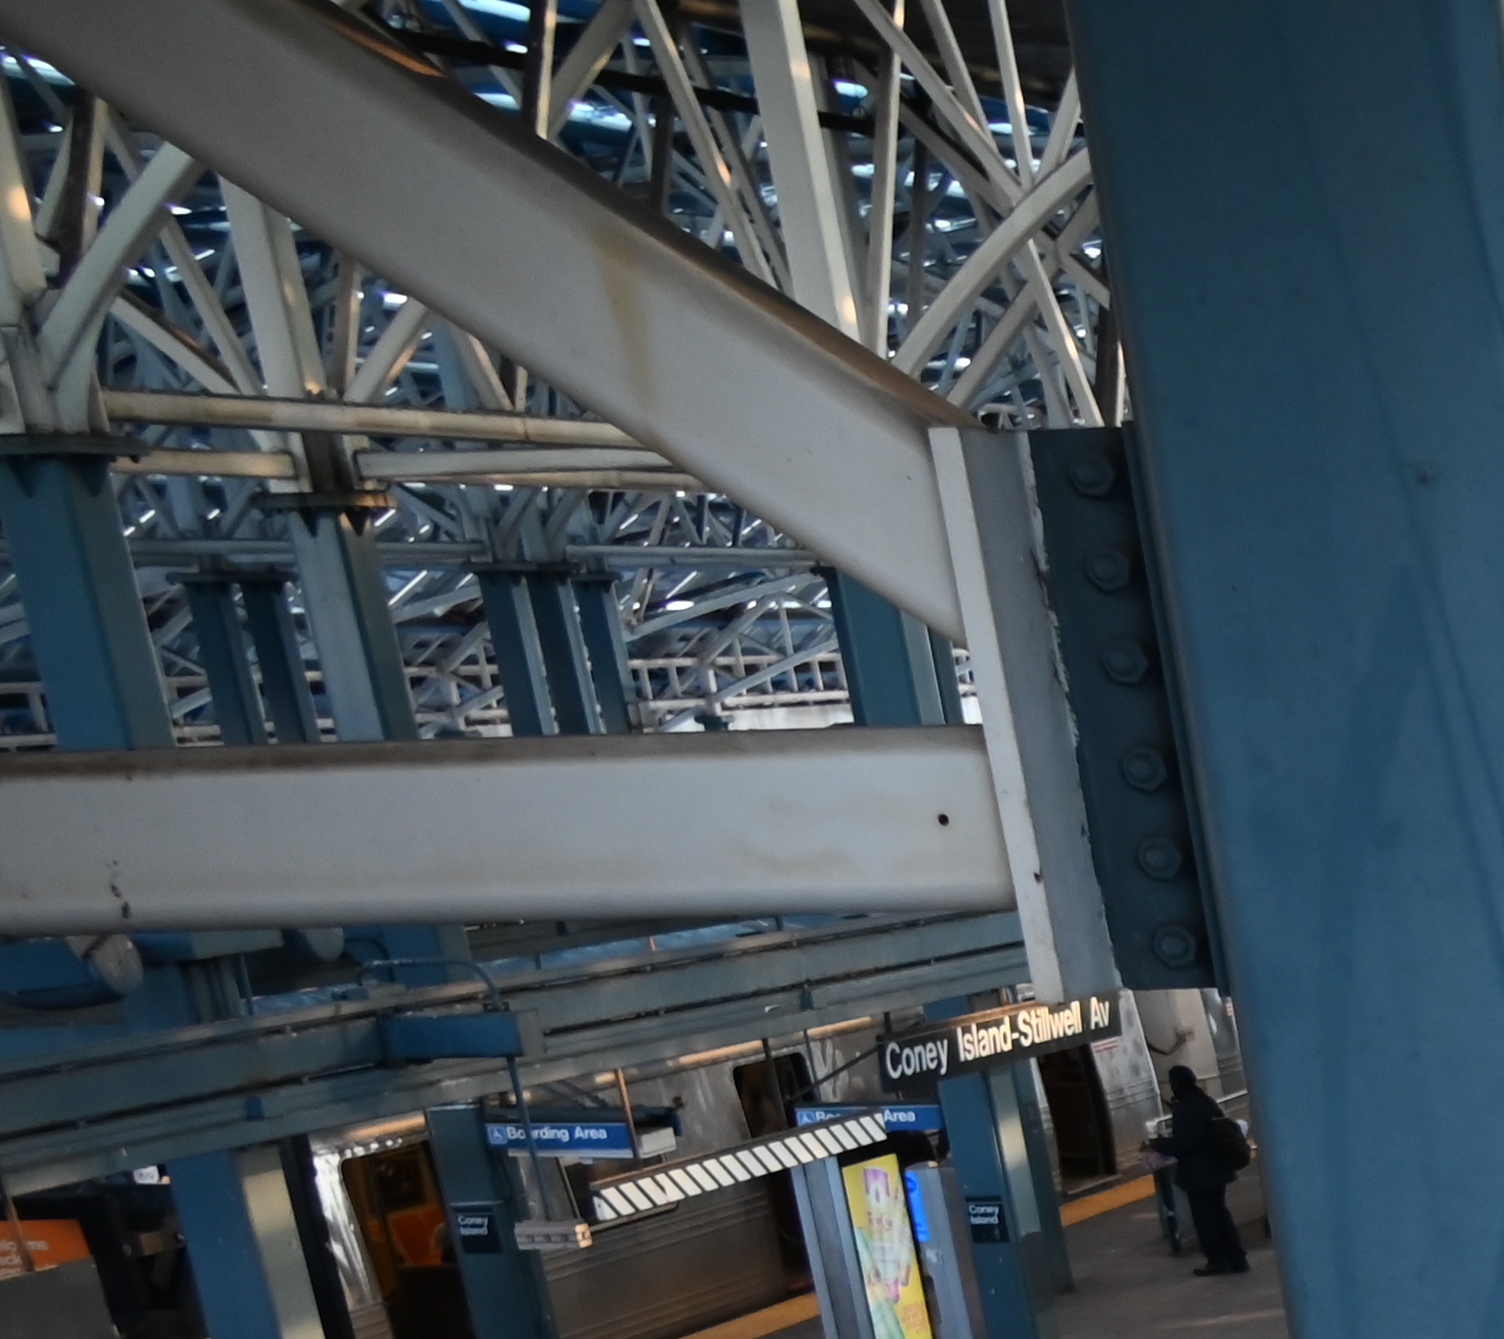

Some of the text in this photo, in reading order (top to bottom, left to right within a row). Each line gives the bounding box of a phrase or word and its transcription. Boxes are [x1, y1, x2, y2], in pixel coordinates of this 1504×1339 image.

[886, 996, 1110, 1079] Coney Island-Stillwell Av
[884, 1109, 916, 1123] Area
[507, 1126, 608, 1143] Bording Area
